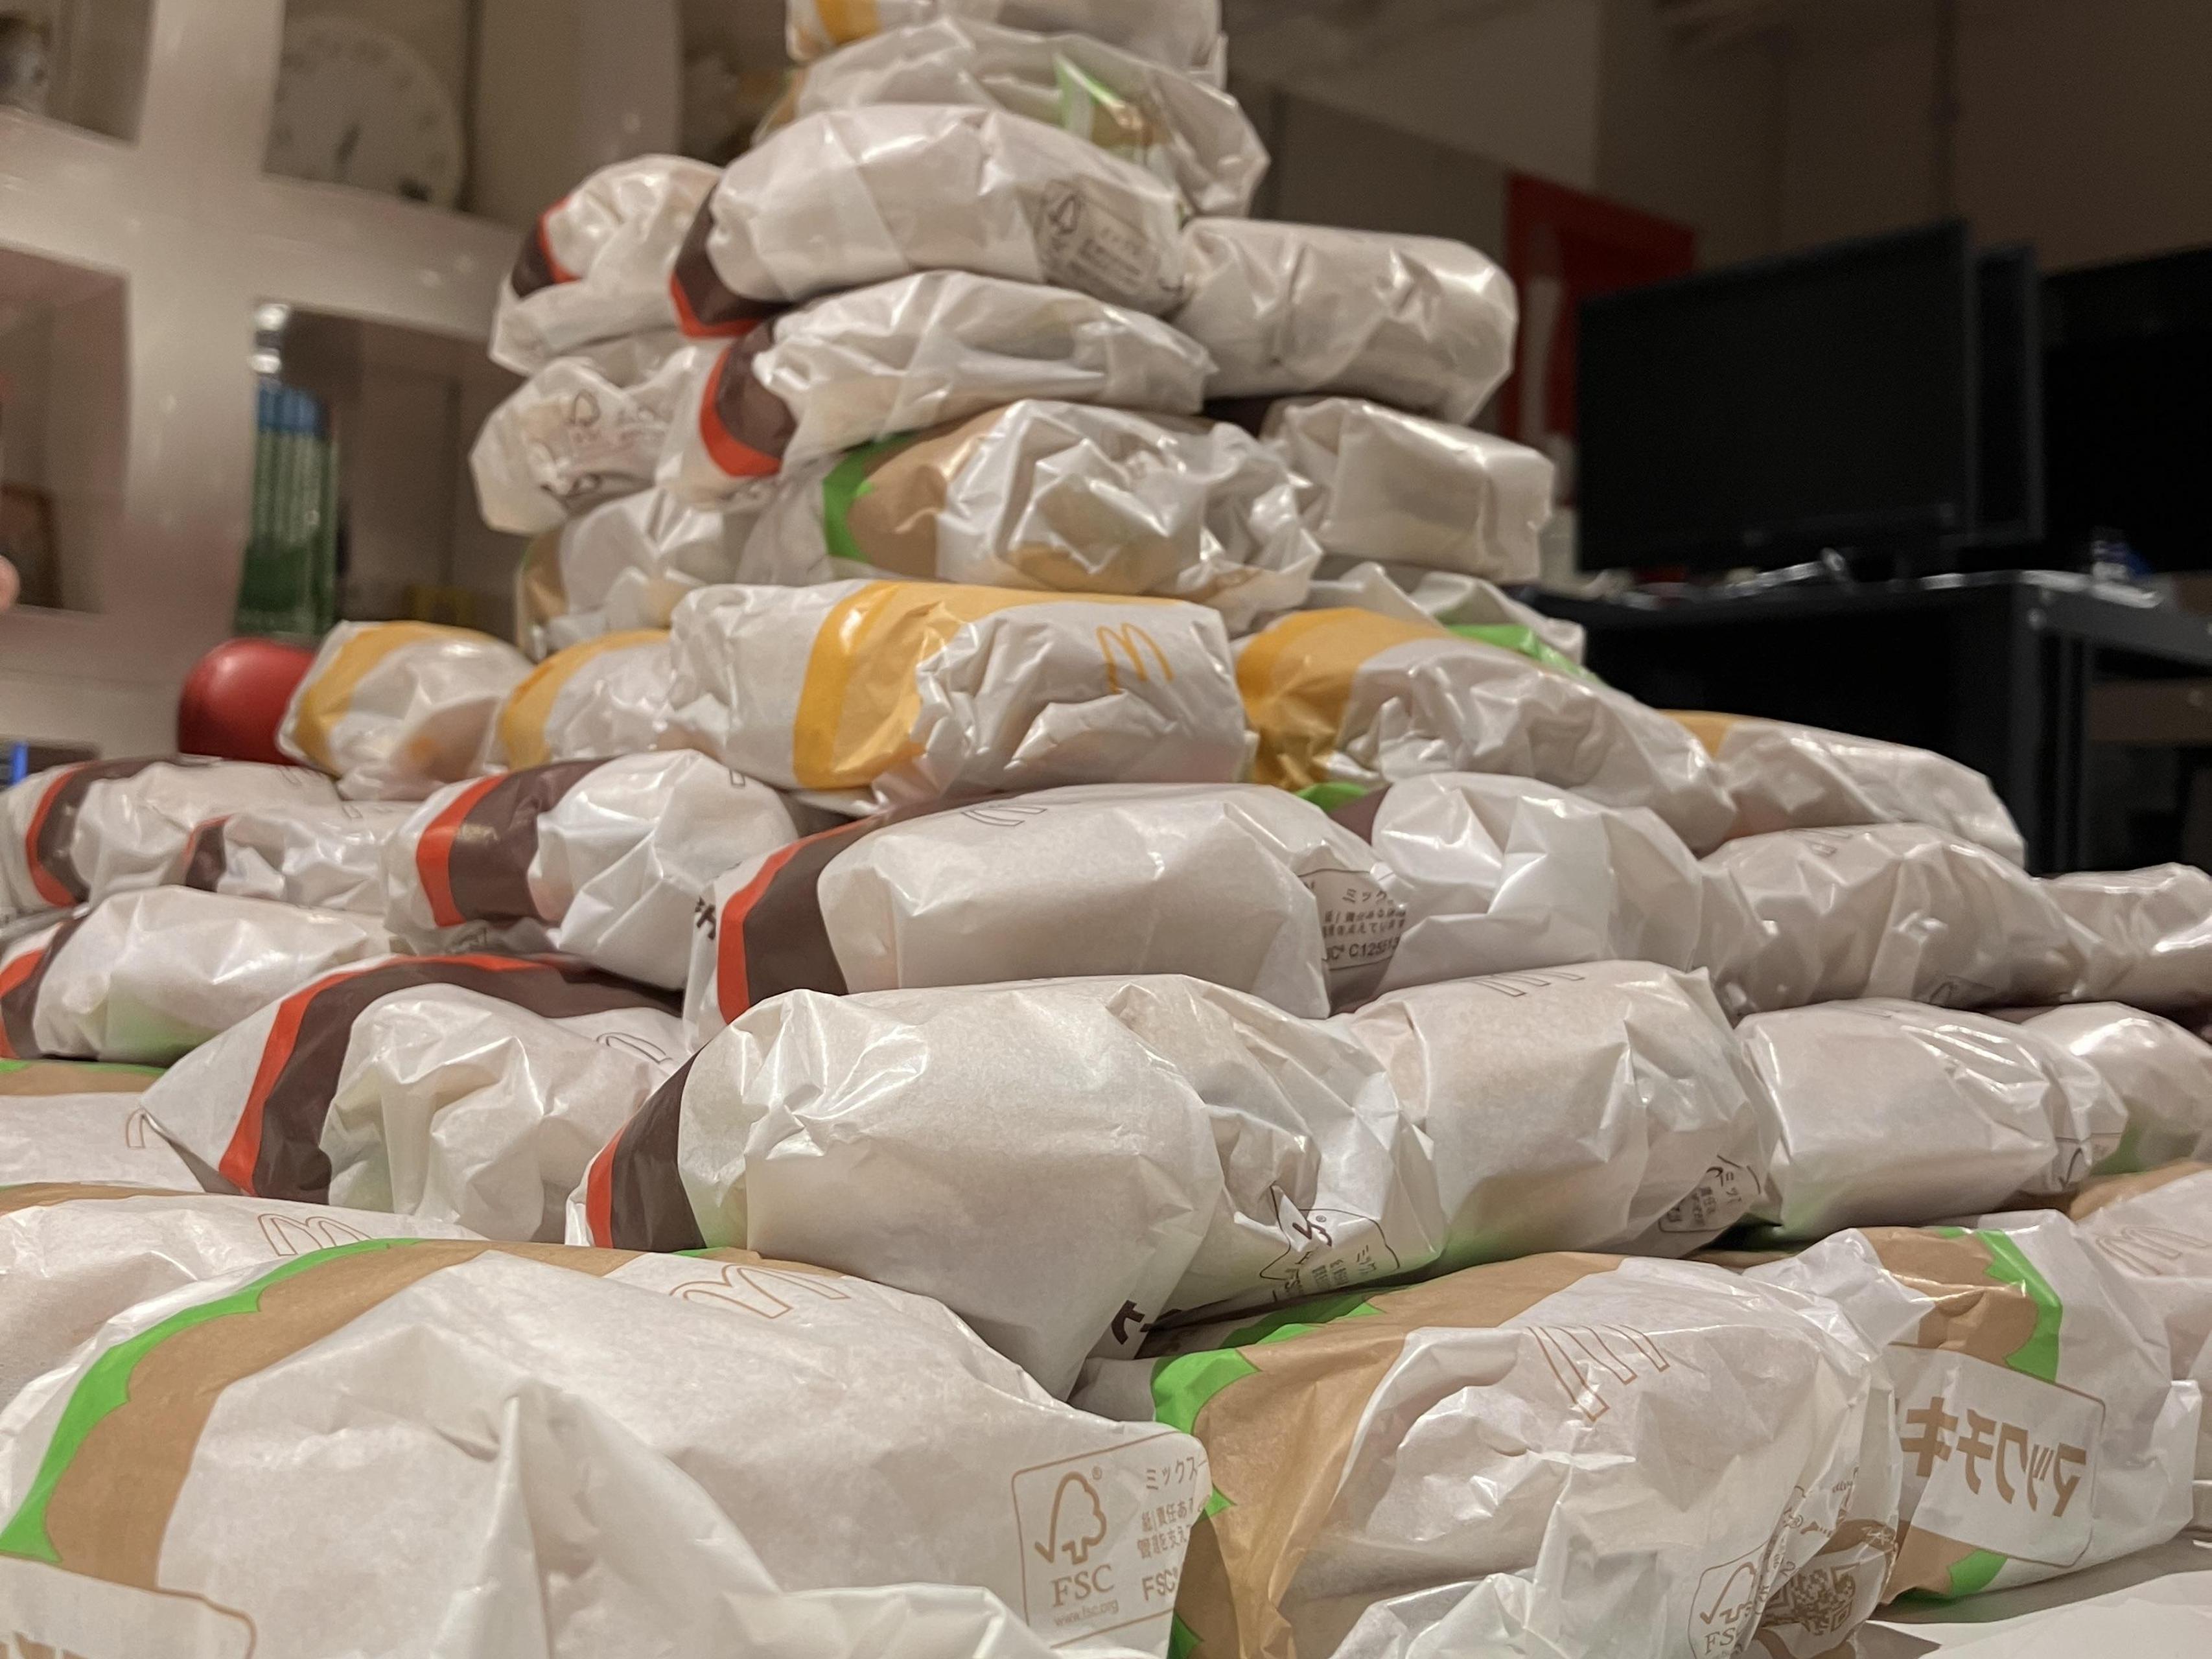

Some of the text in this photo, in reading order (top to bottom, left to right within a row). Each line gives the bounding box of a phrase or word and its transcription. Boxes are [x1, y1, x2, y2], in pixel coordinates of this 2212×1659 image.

[1342, 888, 1394, 904] ミック
[1050, 1563, 1115, 1608] FSC
[1705, 1627, 1737, 1655] FS
